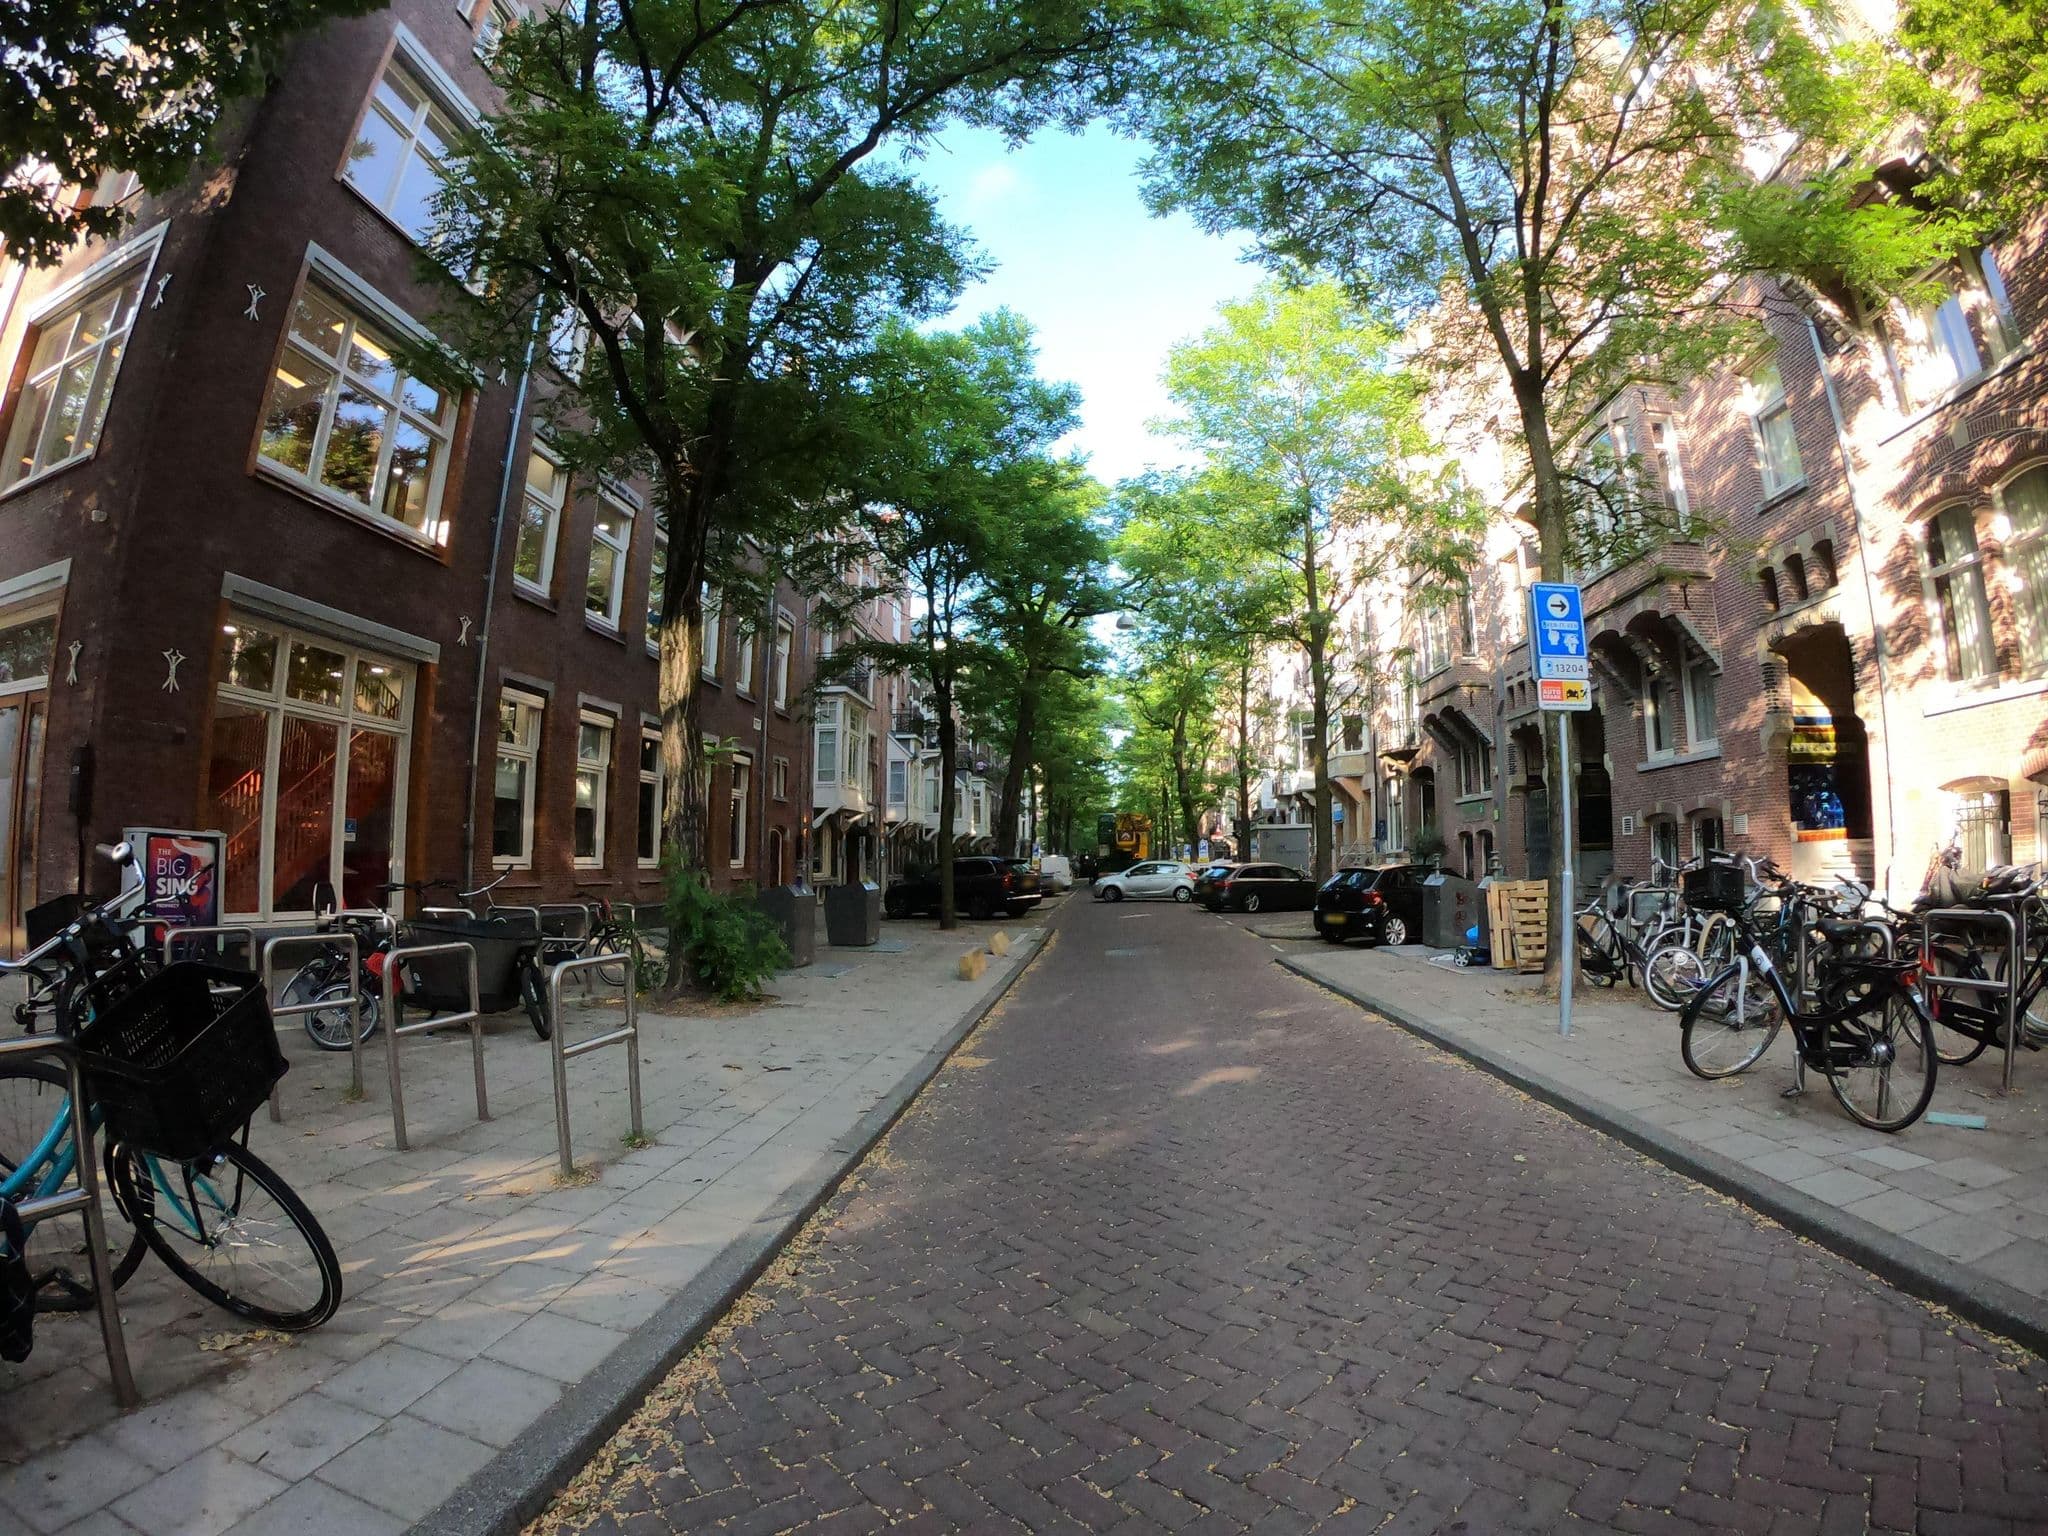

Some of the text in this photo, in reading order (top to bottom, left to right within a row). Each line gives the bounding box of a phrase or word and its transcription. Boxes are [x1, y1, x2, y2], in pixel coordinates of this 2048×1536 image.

[1555, 664, 1584, 673] 13204
[158, 848, 171, 856] THE
[156, 857, 186, 876] BIG
[155, 877, 198, 896] SING
